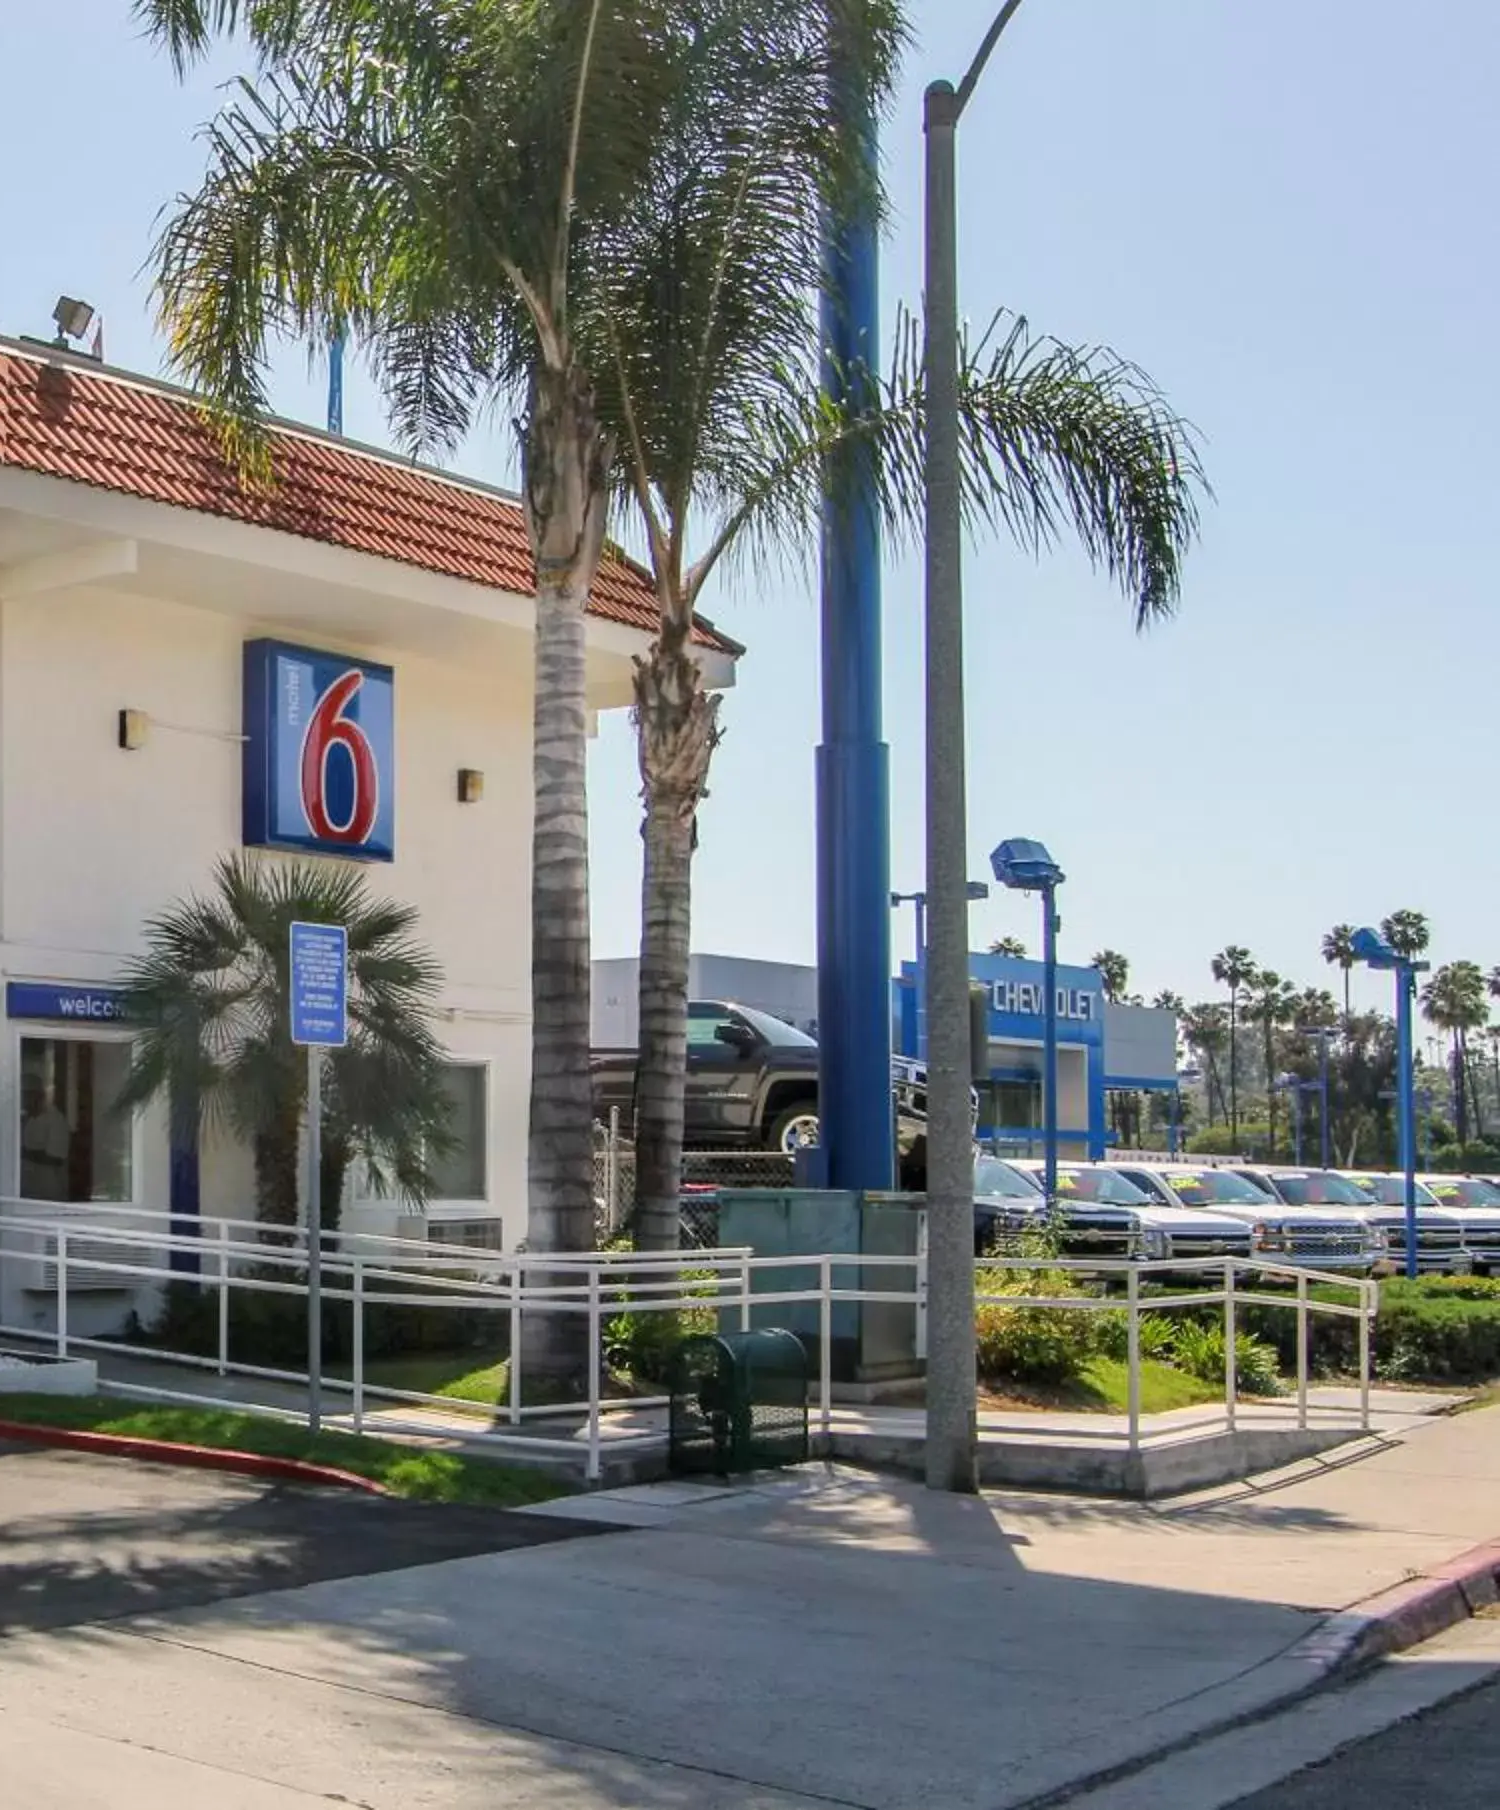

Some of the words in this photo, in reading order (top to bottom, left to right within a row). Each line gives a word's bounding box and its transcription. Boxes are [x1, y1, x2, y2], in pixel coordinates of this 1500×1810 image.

[300, 668, 379, 845] 6
[59, 995, 128, 1018] welco
[993, 980, 1096, 1020] CHEVOLET
